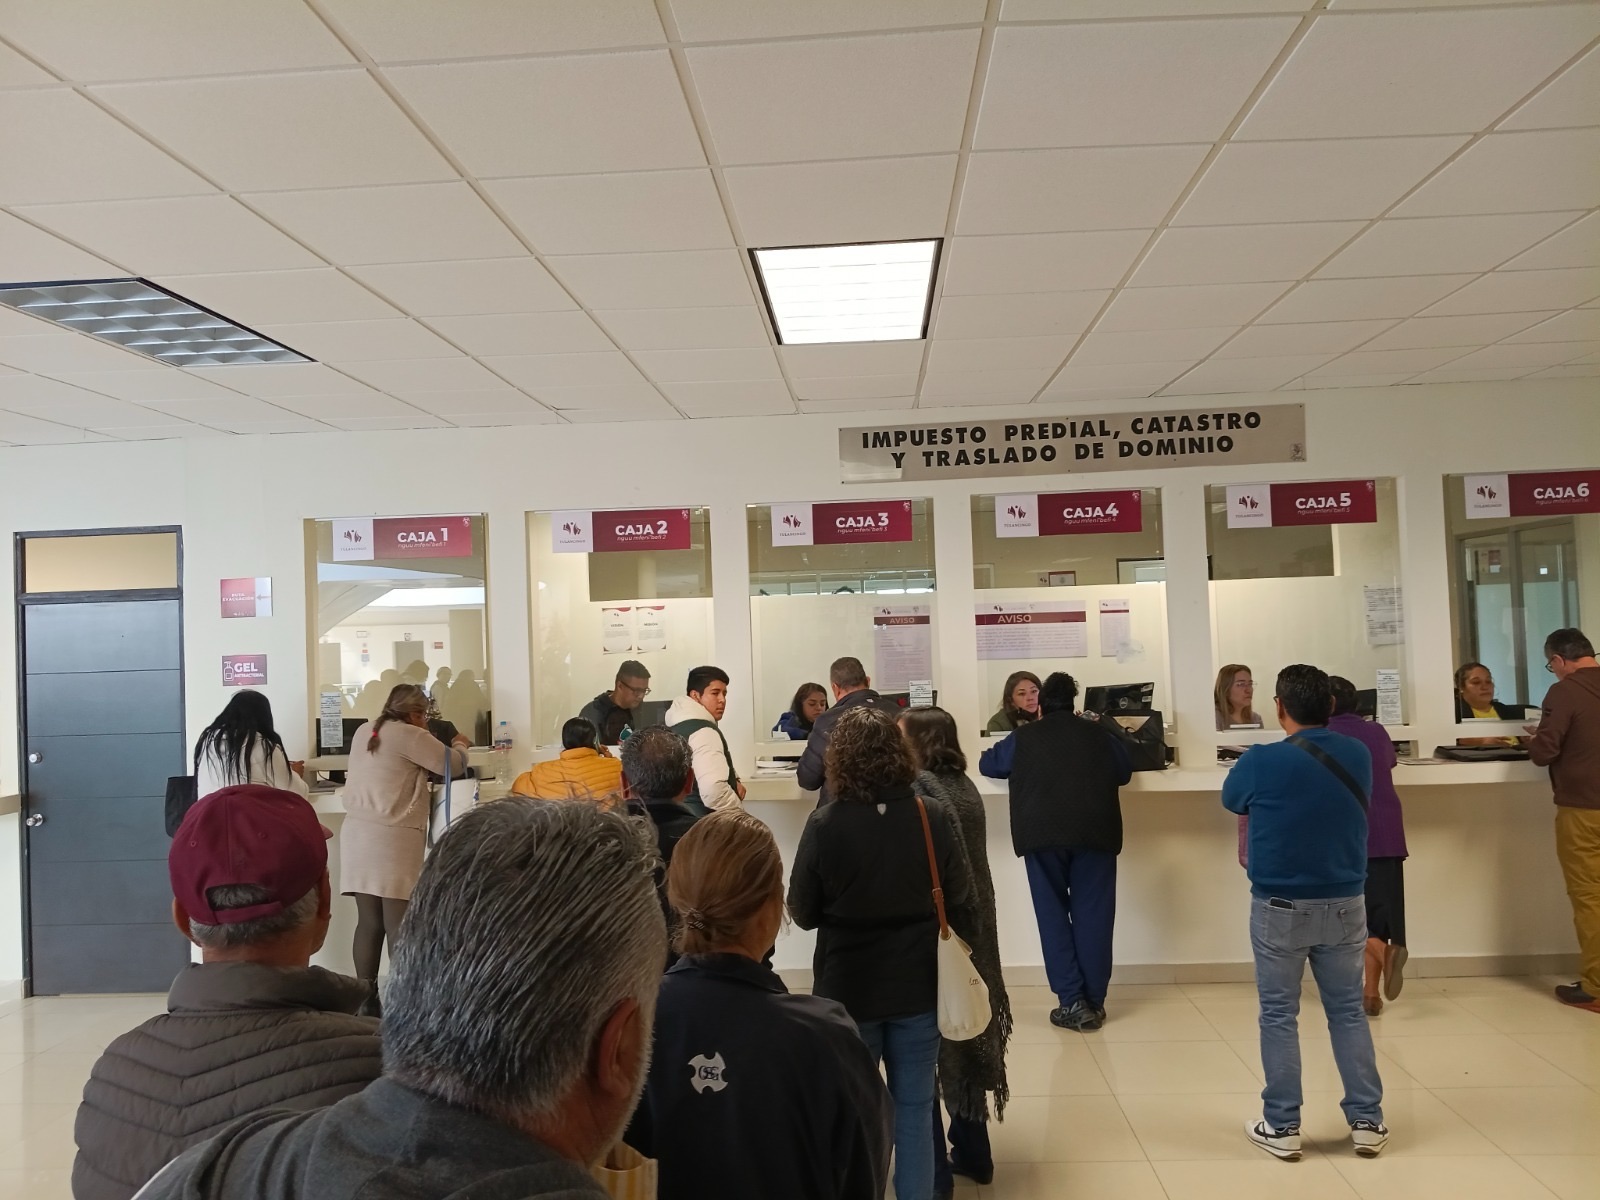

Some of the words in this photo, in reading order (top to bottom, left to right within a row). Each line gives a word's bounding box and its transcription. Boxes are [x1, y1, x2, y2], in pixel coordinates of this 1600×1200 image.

[862, 426, 987, 449] IMPUESTO
[1004, 419, 1121, 442] PREDIAL,
[1130, 411, 1261, 435] CATASTRO
[890, 452, 906, 469] Y
[922, 444, 1057, 467] TRASLADO
[1074, 442, 1104, 460] DE
[1118, 435, 1234, 458] DOMINIO
[1533, 486, 1576, 500] CAJA
[1577, 482, 1590, 498] 6
[1295, 496, 1338, 509] CAJA
[1339, 492, 1352, 507] 5
[1063, 506, 1104, 519] CAJA
[1105, 502, 1119, 517] 4
[615, 524, 654, 536] CAJA
[656, 520, 668, 535] 2
[835, 516, 876, 528] CAJA
[878, 512, 889, 527] 3
[397, 531, 437, 543] CAJA
[440, 527, 448, 542] 1
[997, 614, 1032, 624] AVISO
[234, 662, 258, 673] GEL
